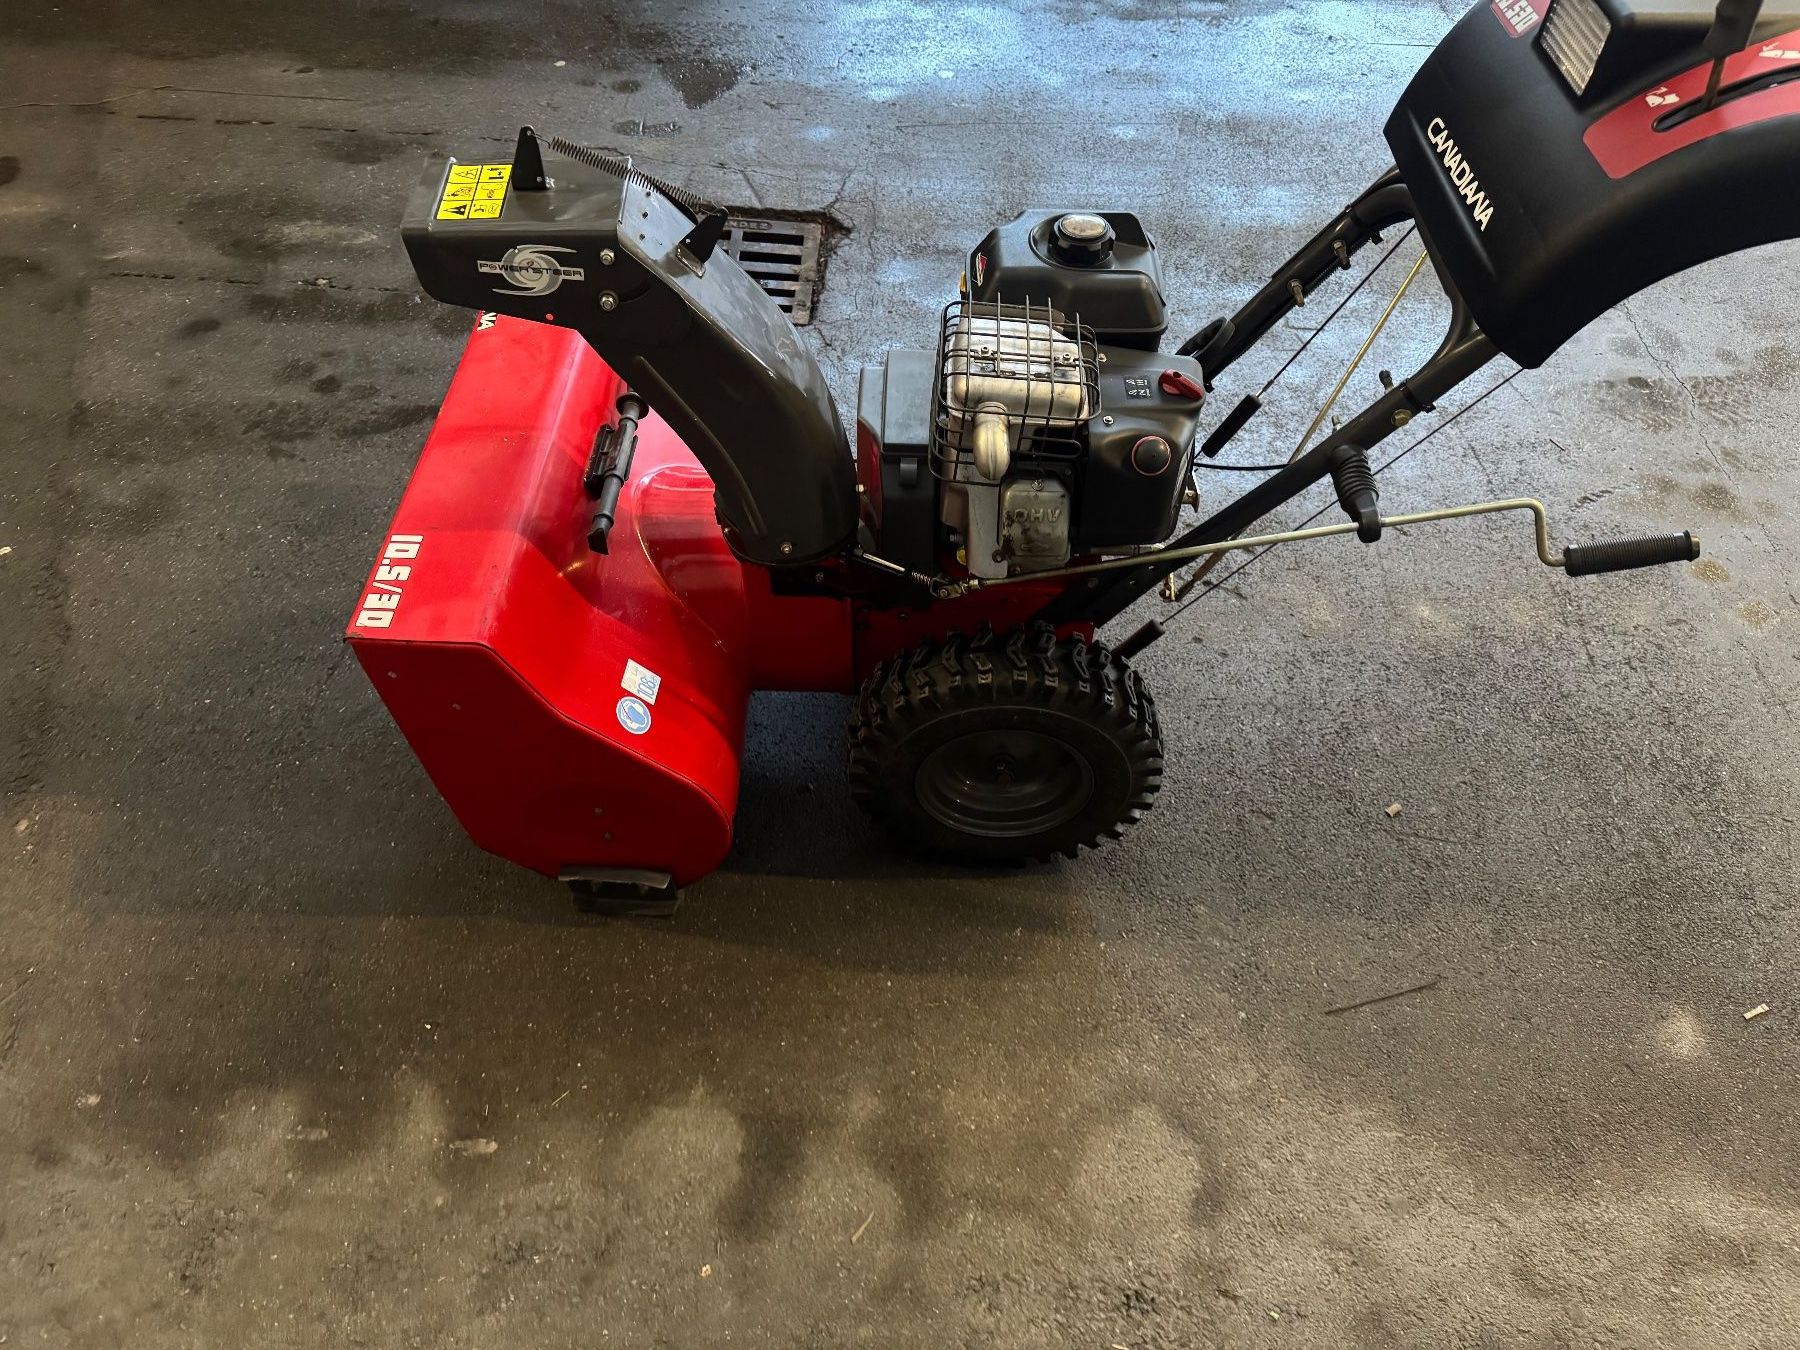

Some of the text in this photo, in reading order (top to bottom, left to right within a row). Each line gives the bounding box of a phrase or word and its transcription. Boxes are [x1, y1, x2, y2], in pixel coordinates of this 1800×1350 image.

[1427, 117, 1494, 232] CANADIANA
[1014, 508, 1061, 522] OHV
[355, 534, 424, 628] 10.5/30
